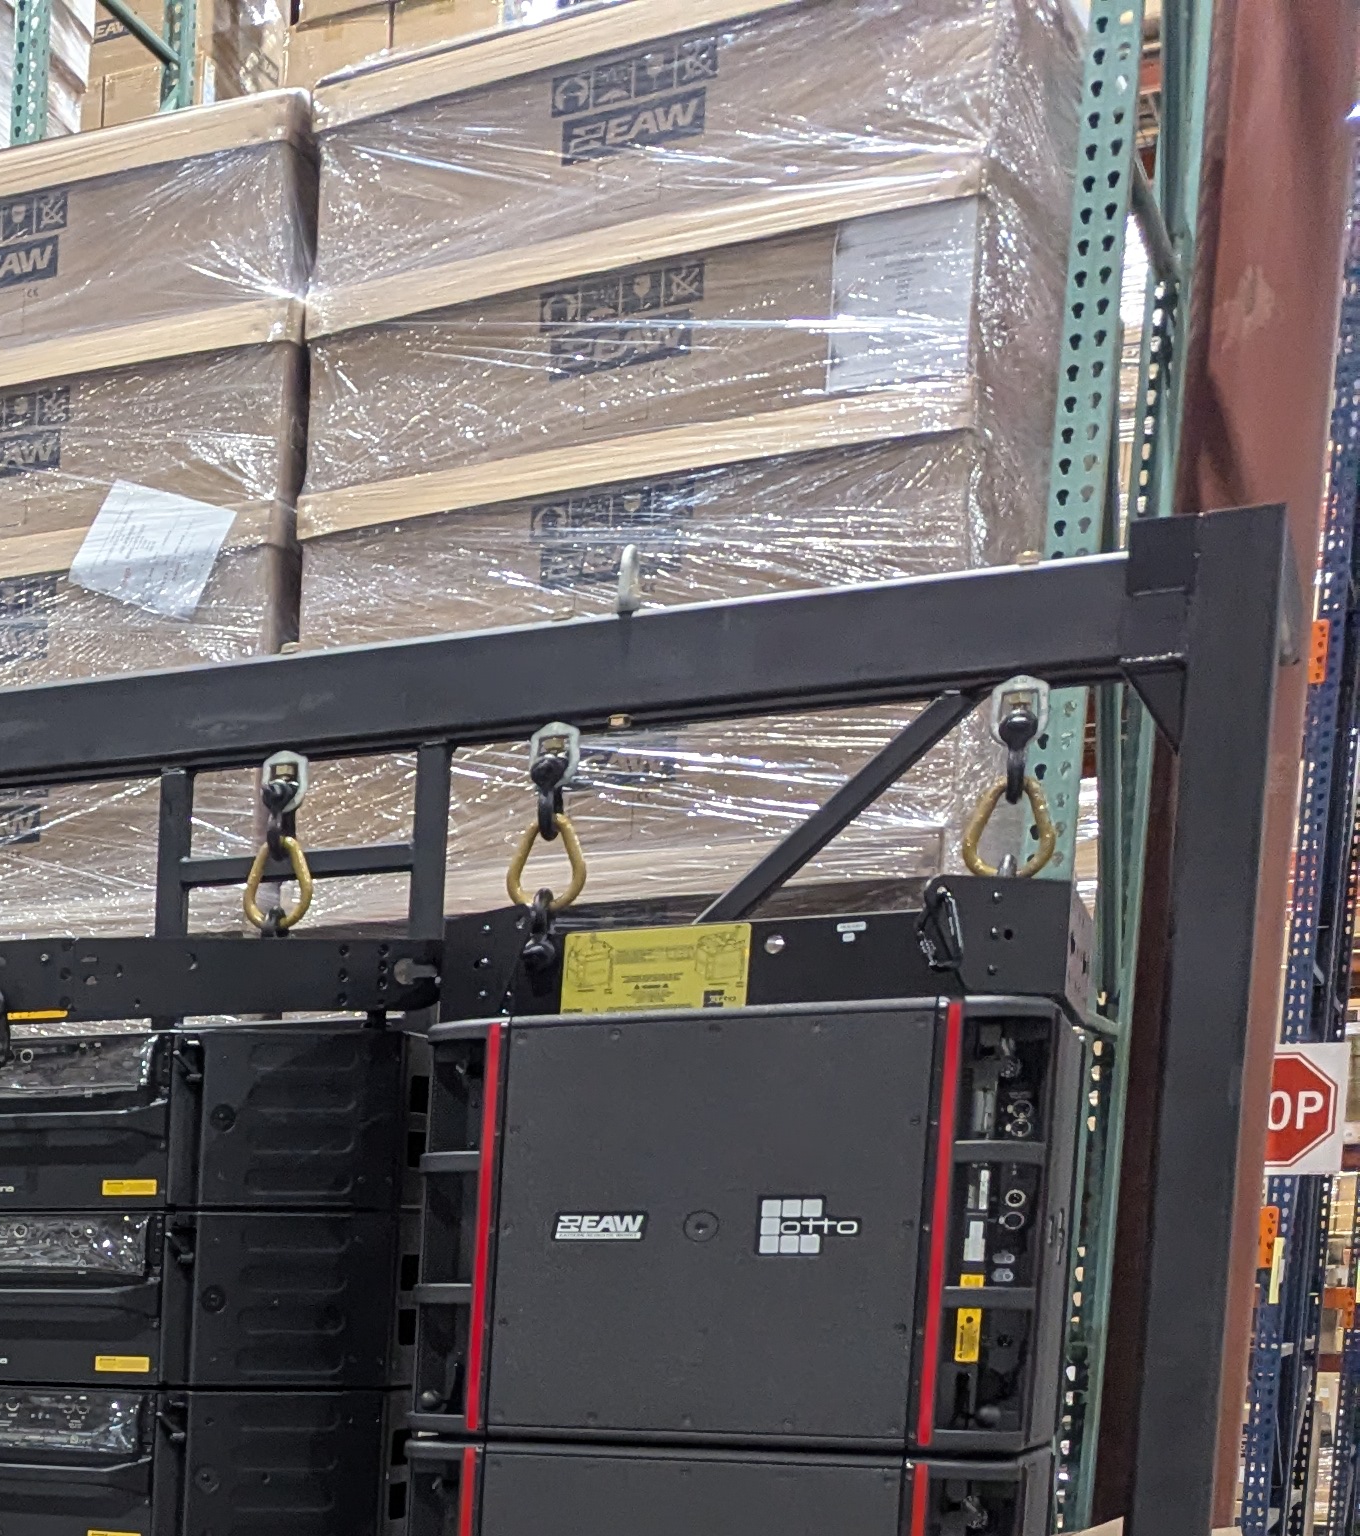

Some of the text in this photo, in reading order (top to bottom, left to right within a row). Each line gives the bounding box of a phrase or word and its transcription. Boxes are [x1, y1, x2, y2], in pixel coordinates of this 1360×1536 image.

[606, 98, 700, 144] EAW
[1268, 1090, 1324, 1131] OP
[580, 1215, 644, 1232] EAW
[780, 1217, 858, 1236] otto
